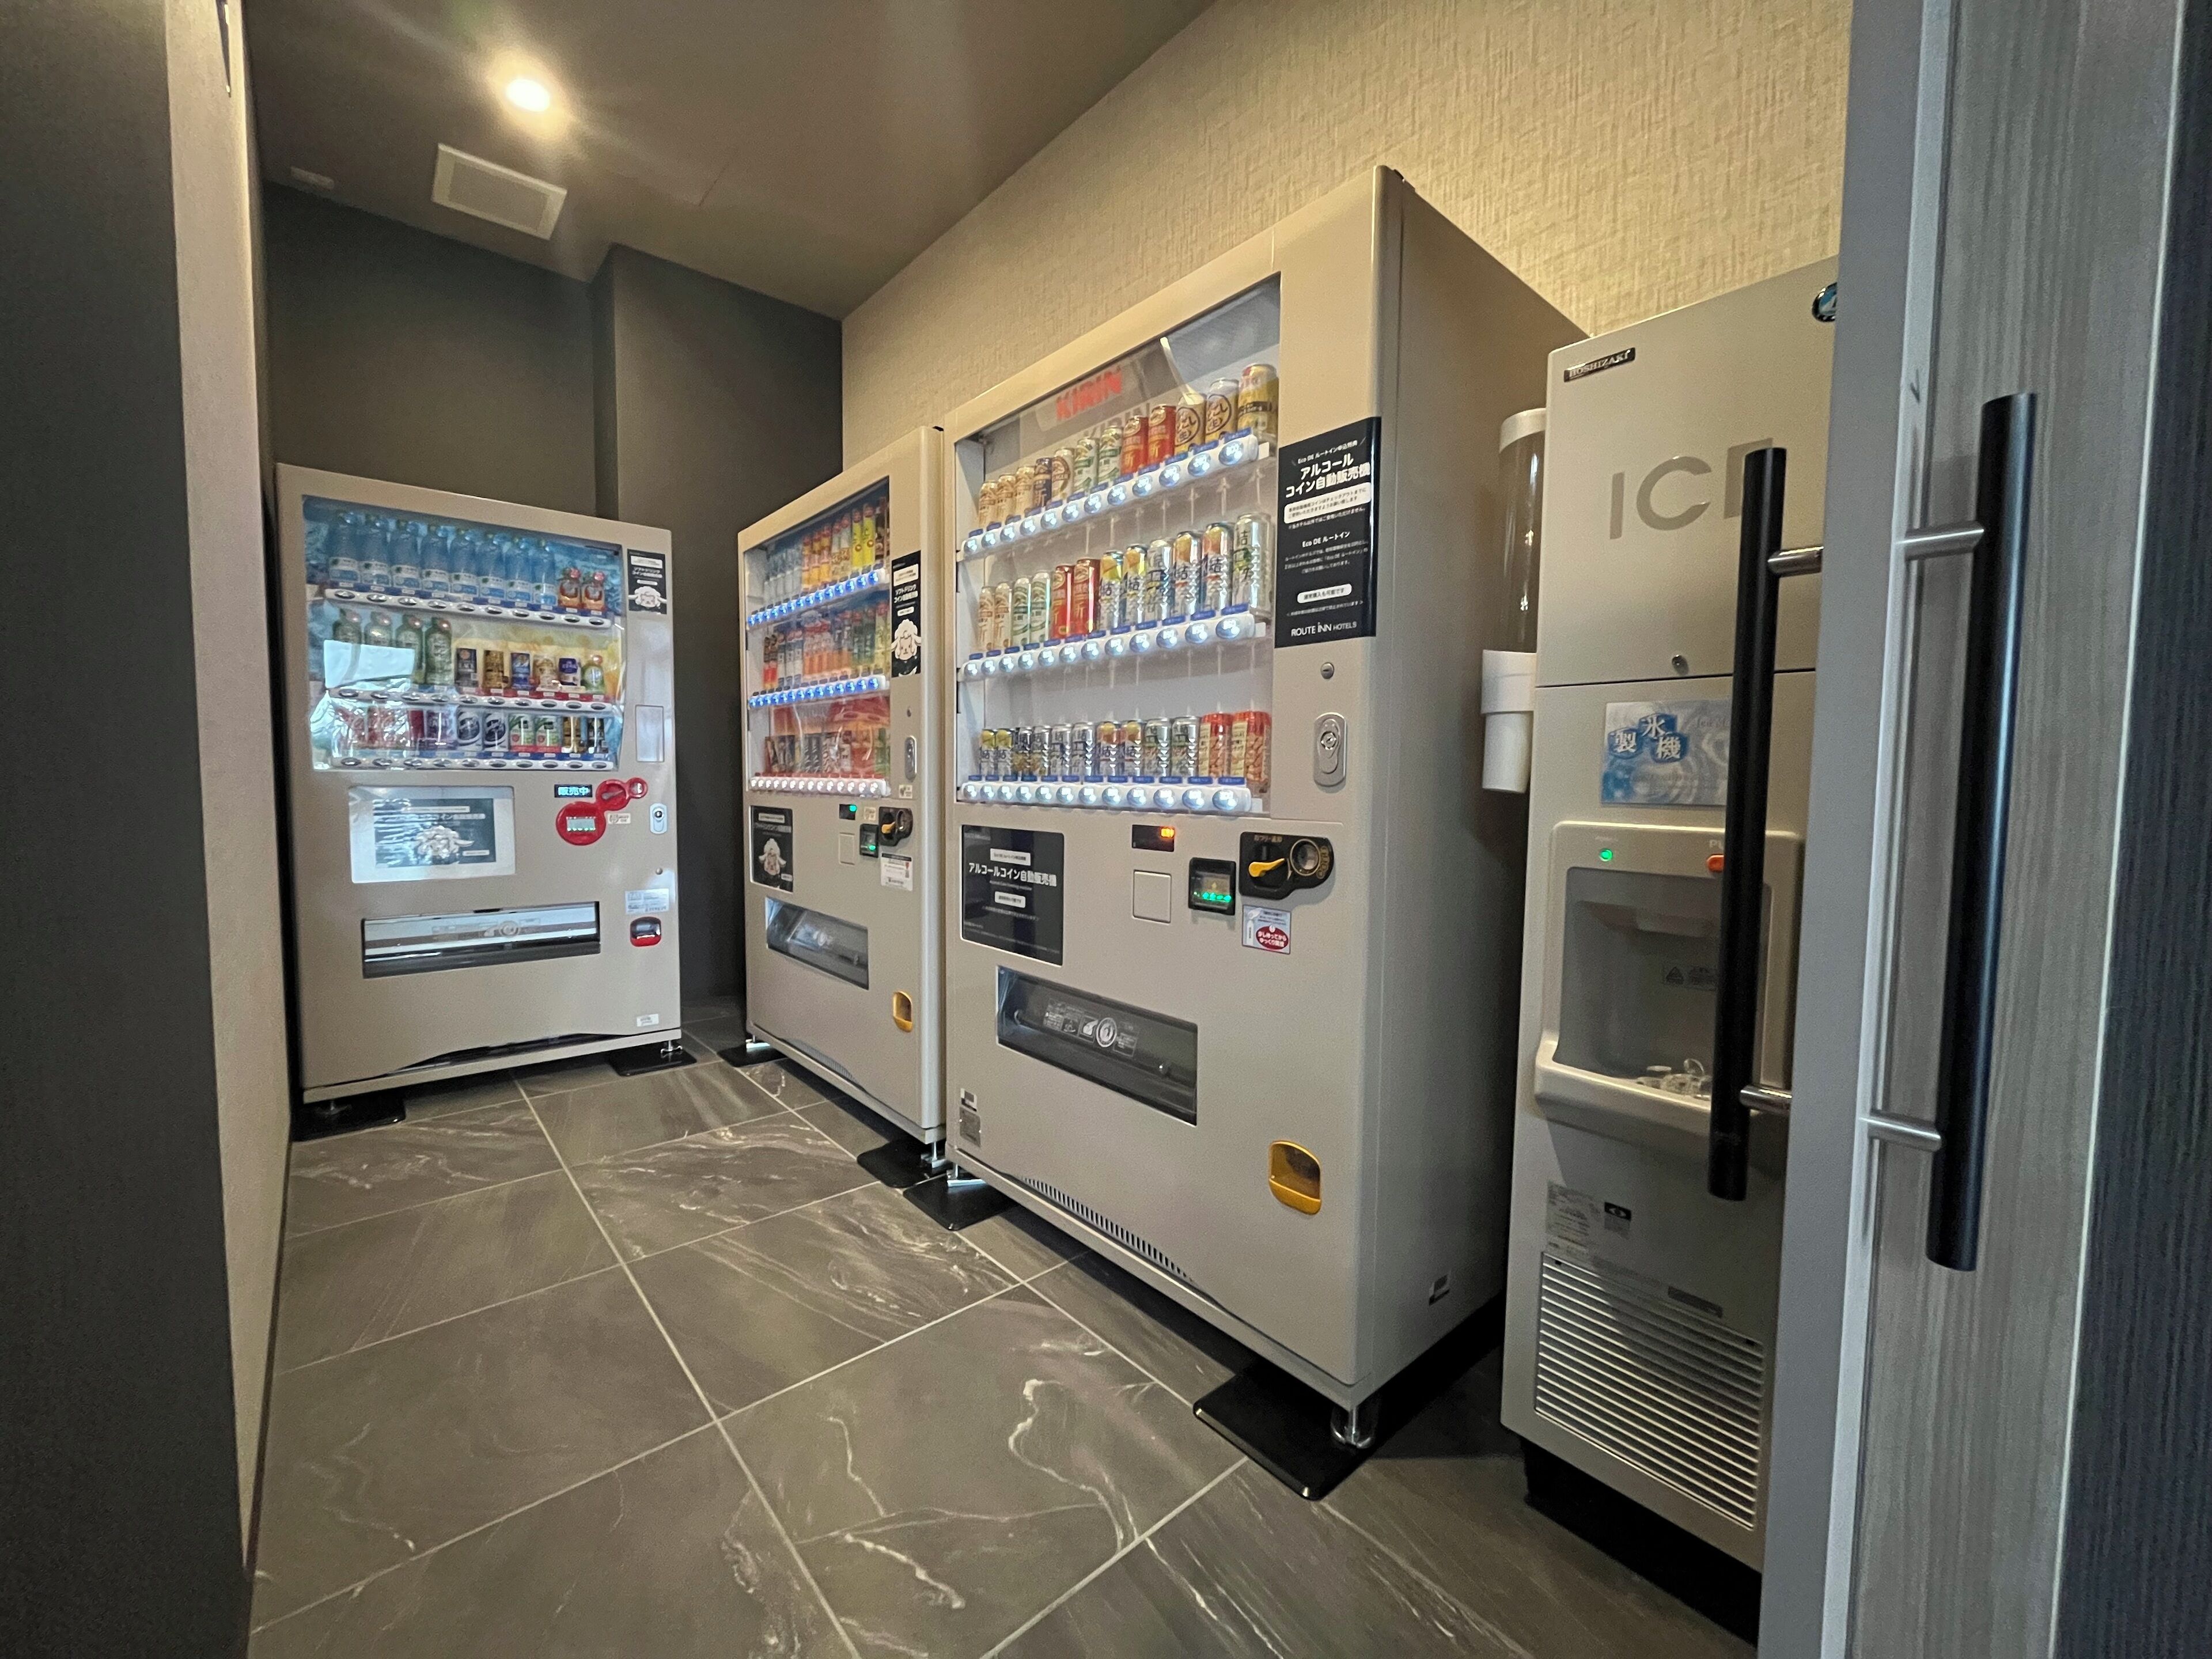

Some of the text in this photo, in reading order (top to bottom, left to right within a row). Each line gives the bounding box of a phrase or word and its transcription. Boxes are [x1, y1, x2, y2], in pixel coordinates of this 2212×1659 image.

[1569, 350, 1630, 378] HOSHIZAKI
[1300, 453, 1354, 480] アルコール
[1285, 462, 1370, 498] コイン自動販売機
[1323, 531, 1350, 543] ルートイン
[1291, 626, 1316, 637] ROUTE
[1333, 622, 1357, 630] HOTELS
[558, 786, 589, 796] 販売中
[968, 862, 1058, 887] アルコールコイン自動販売機
